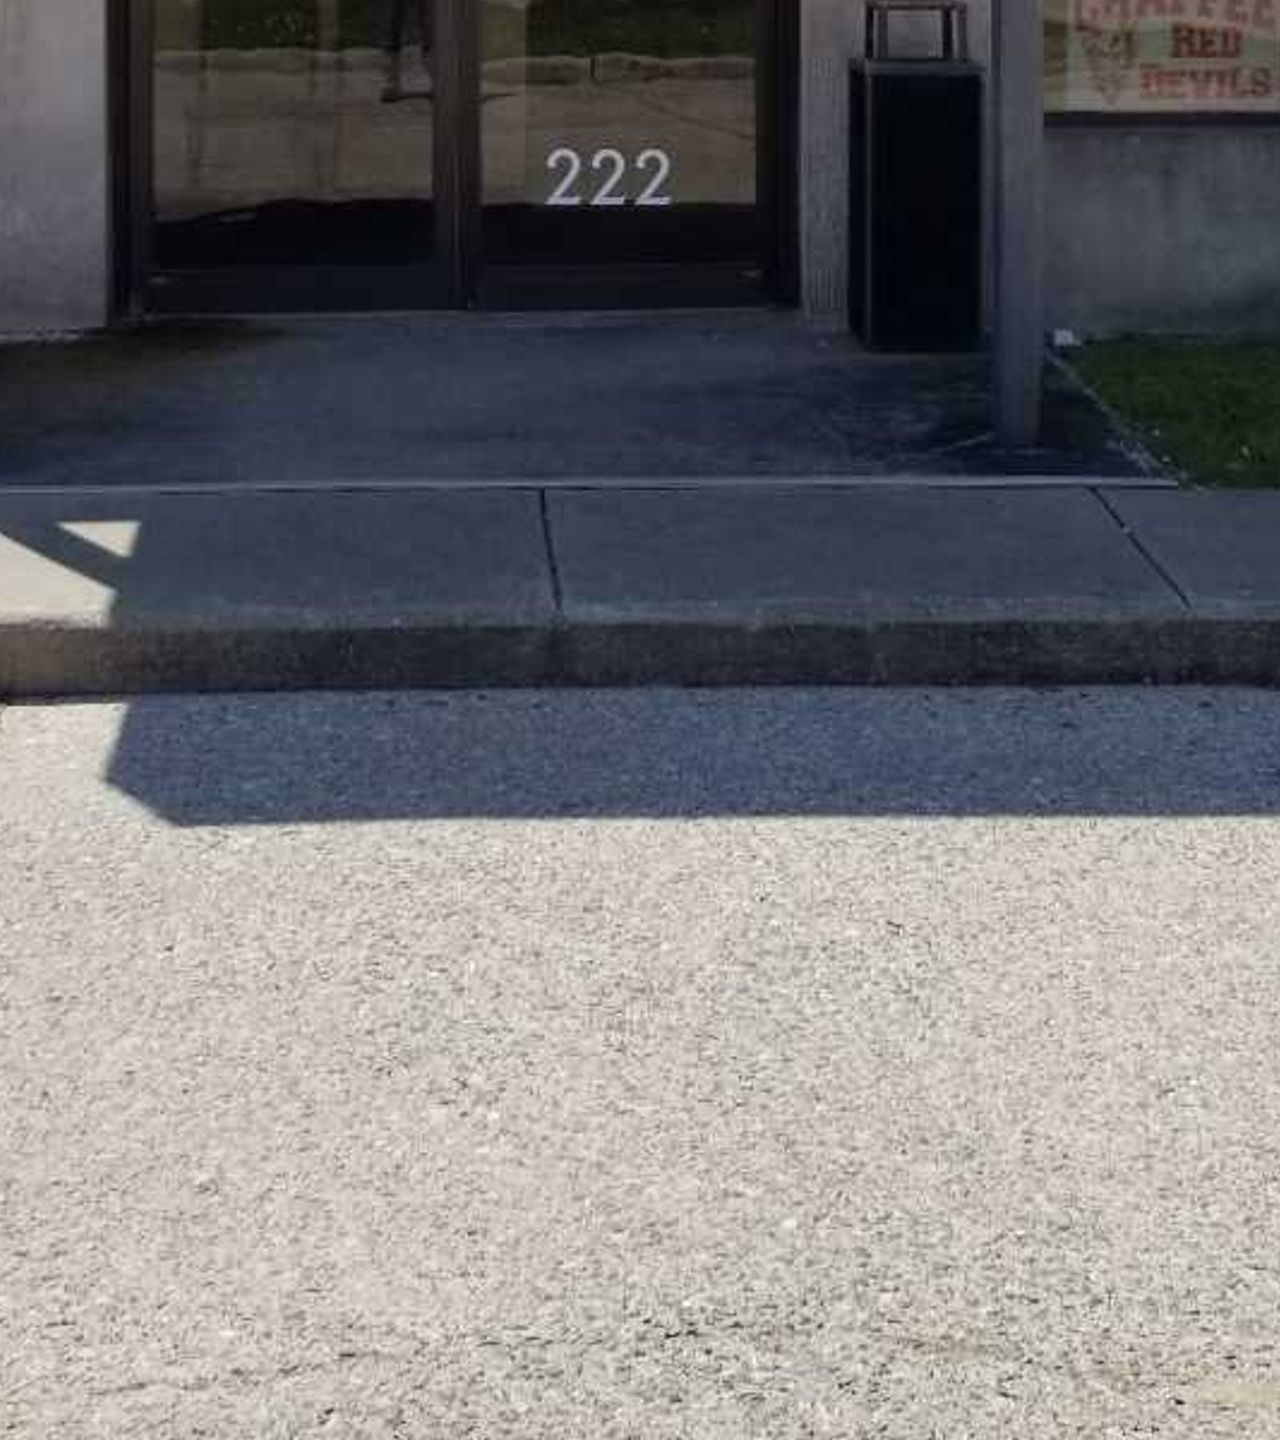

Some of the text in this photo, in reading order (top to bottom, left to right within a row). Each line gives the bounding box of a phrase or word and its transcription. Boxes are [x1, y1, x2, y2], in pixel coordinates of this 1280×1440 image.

[1171, 22, 1243, 59] RED
[1138, 64, 1272, 98] DEVILS
[545, 147, 673, 206] 222
